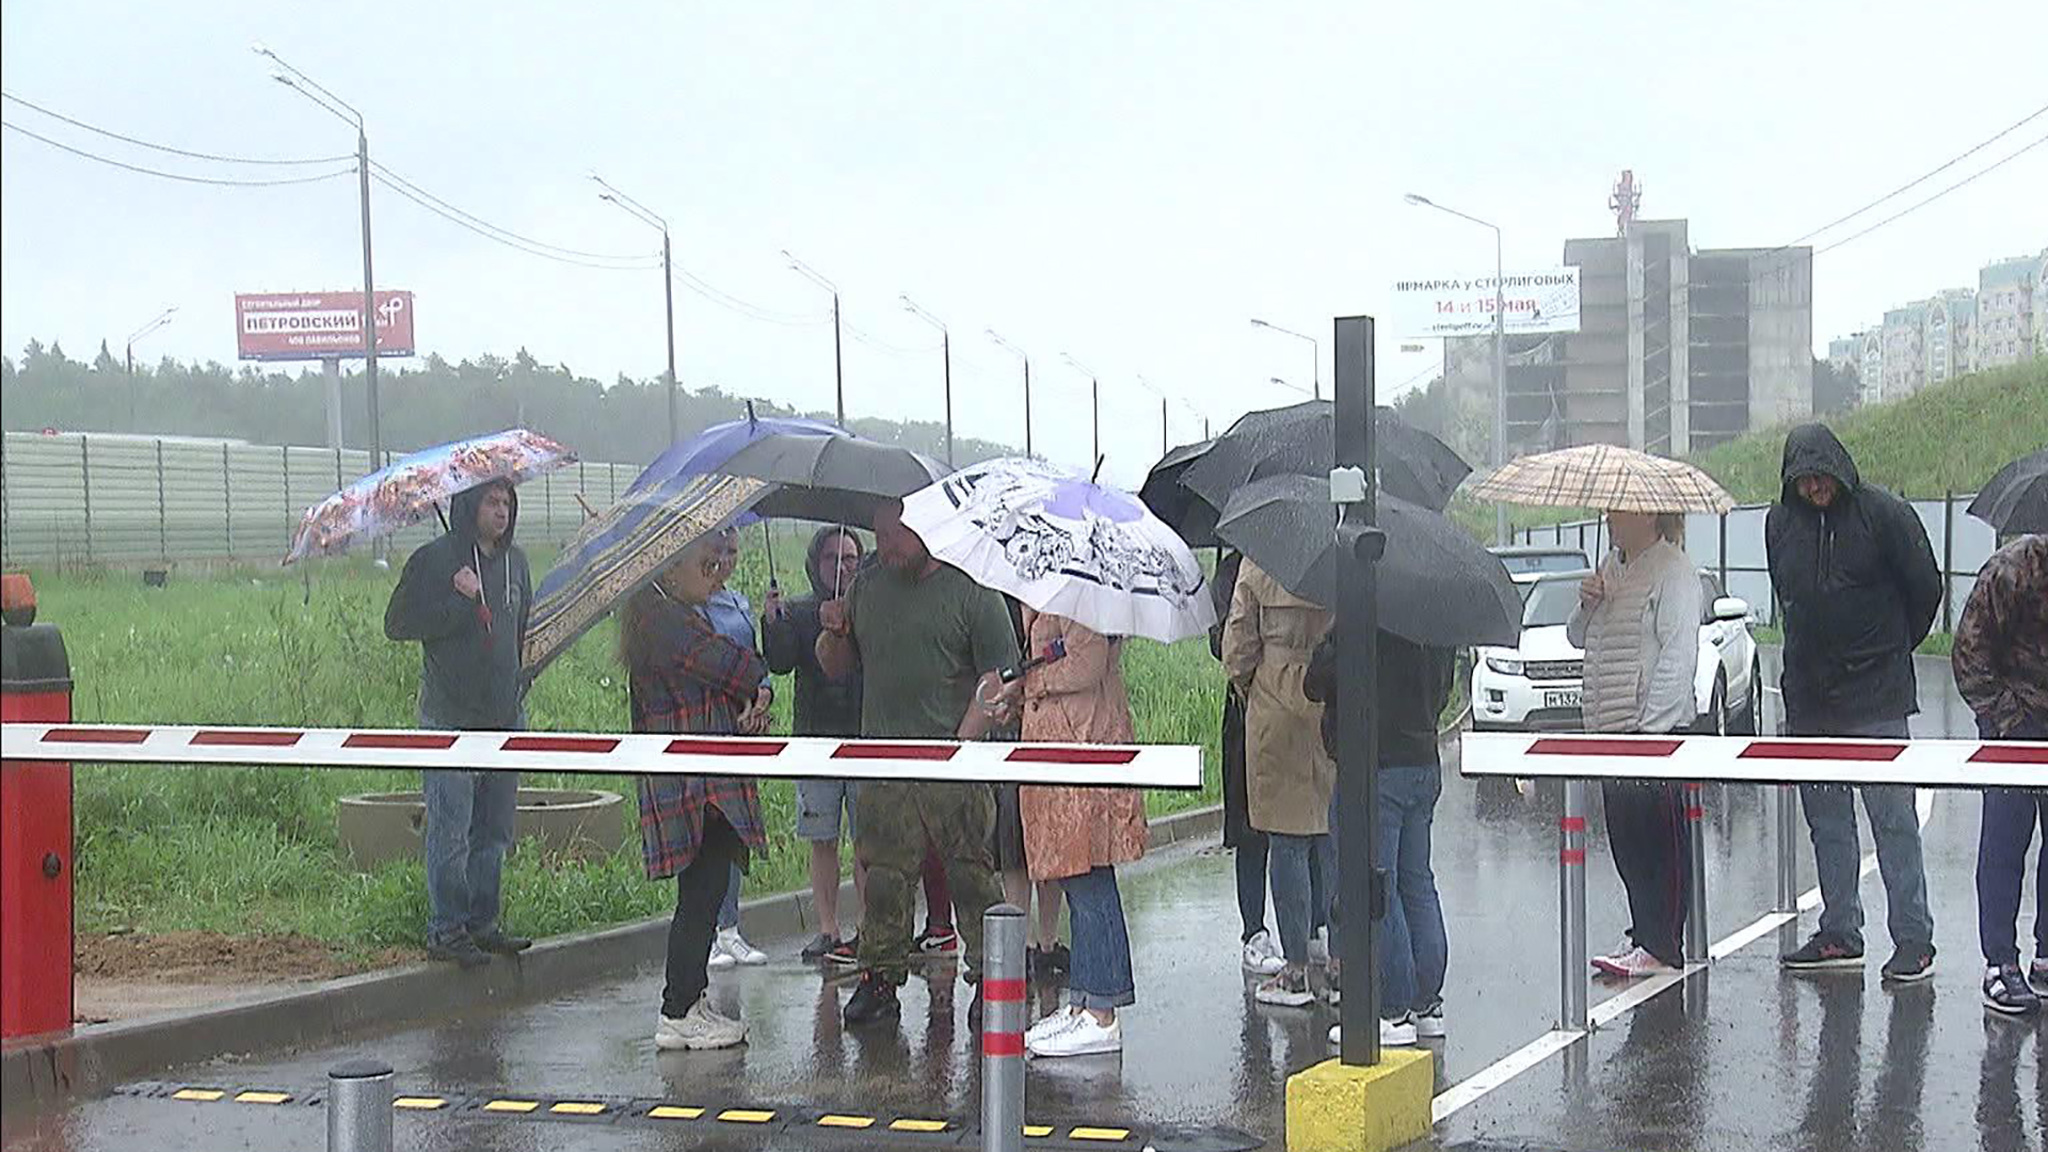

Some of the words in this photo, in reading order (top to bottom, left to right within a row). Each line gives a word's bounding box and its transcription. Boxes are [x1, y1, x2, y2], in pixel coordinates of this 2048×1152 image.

[1397, 280, 1460, 292] ЯРМАРКА
[1436, 300, 1454, 313] 14
[1460, 302, 1471, 313] и
[1477, 299, 1495, 313] 15
[1501, 299, 1536, 313] мая
[246, 314, 357, 330] ПЕТРОВСКИЙ
[1548, 693, 1583, 706] М132
